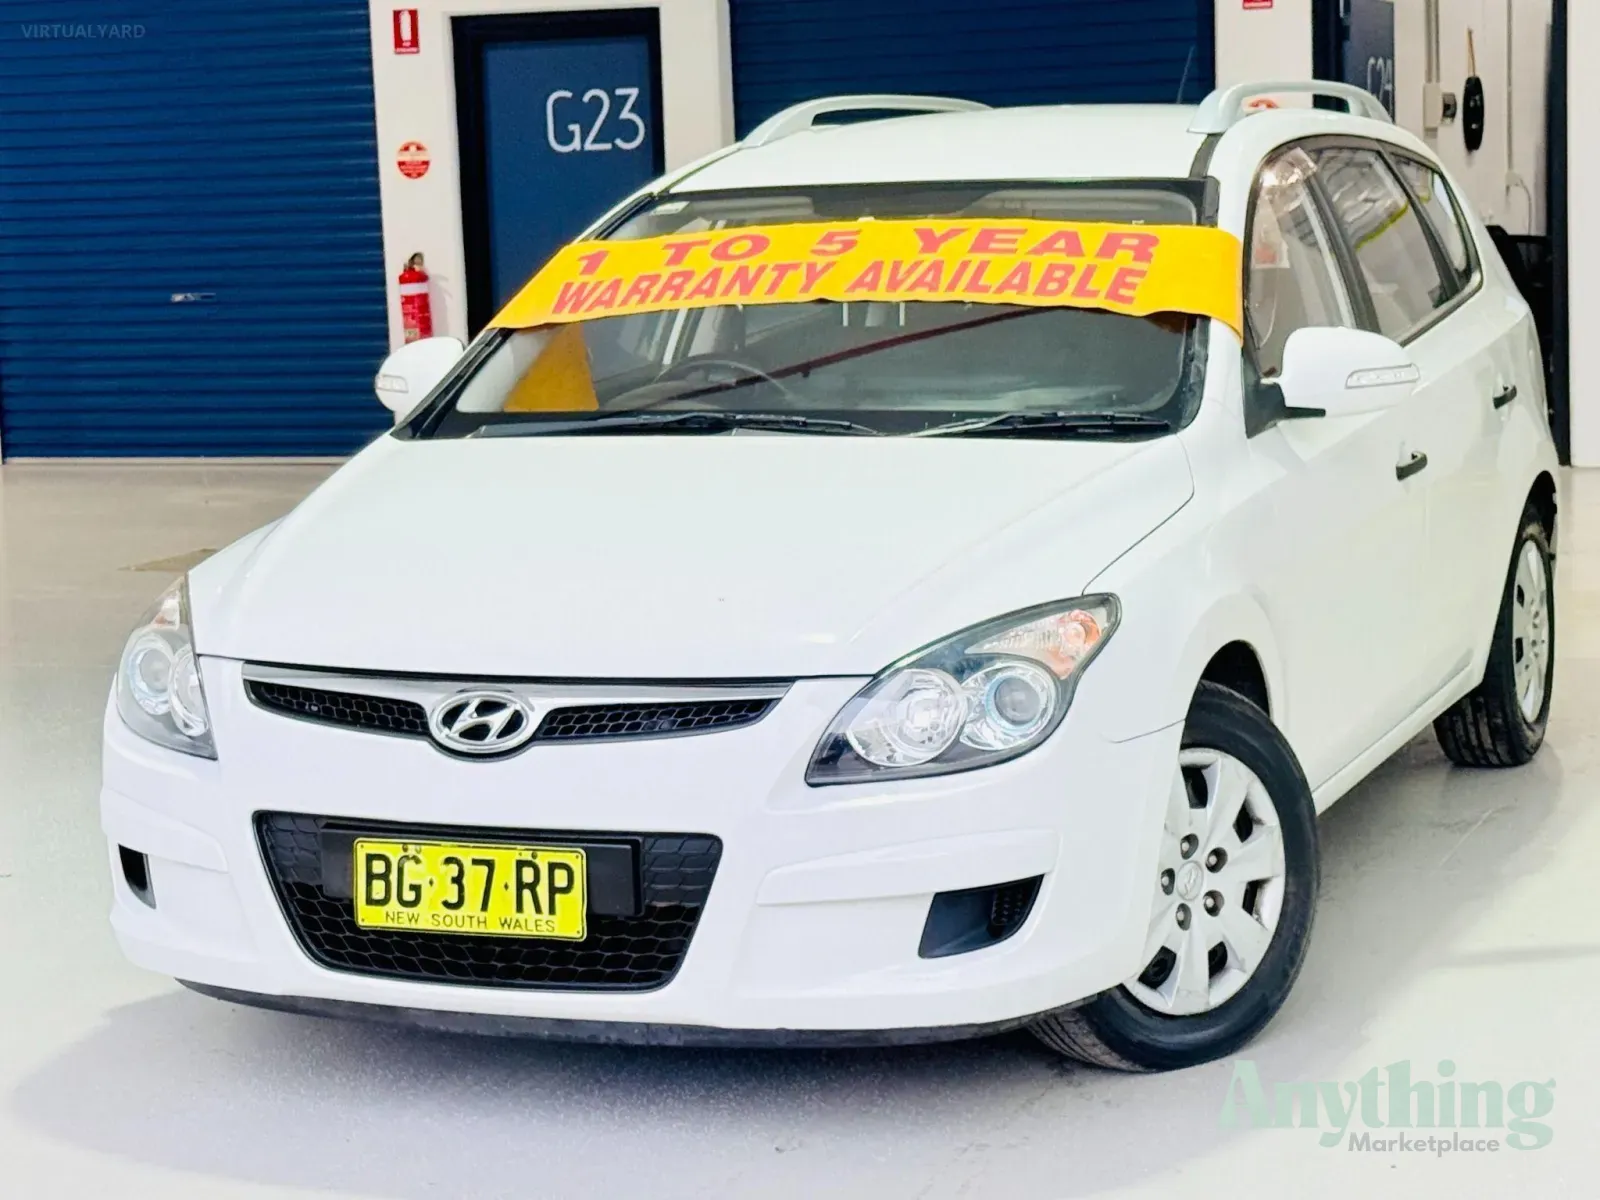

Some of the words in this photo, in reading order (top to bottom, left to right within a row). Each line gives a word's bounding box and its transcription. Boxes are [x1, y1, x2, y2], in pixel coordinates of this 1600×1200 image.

[546, 87, 646, 153] G23
[577, 250, 609, 275] 1
[662, 234, 771, 266] TO
[810, 229, 862, 256] 5
[913, 227, 1160, 264] YEAR
[551, 261, 838, 315] WARRANTY
[844, 258, 1148, 305] AVAILABLE
[385, 911, 420, 925] NEW
[432, 914, 487, 928] SOUTH
[499, 917, 555, 933] WALES
